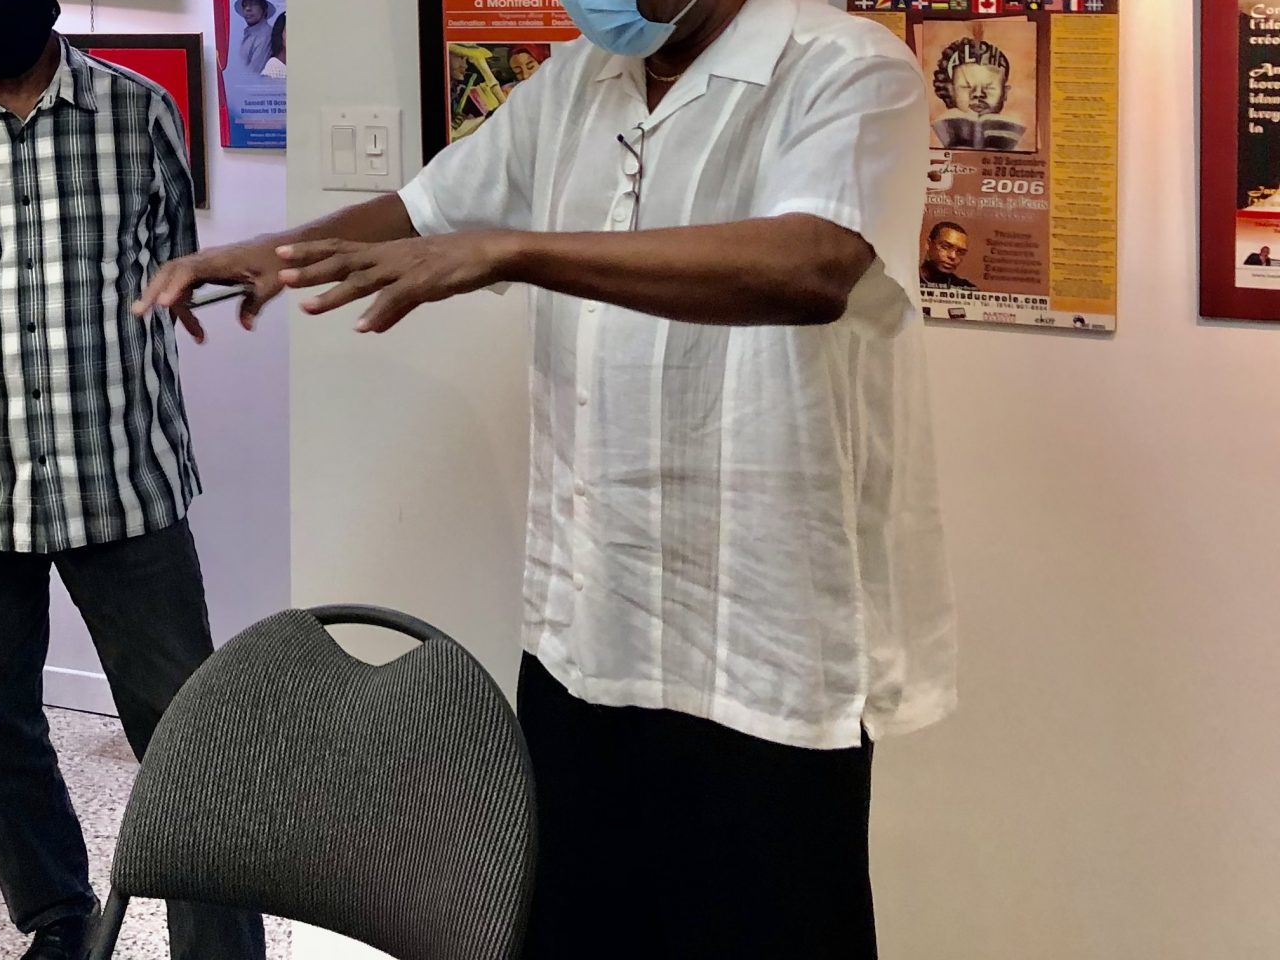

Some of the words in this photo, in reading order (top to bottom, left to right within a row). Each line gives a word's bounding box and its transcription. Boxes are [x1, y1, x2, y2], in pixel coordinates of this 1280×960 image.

[1005, 156, 1046, 167] Septembre
[982, 168, 992, 176] au
[1009, 167, 1045, 178] Octobre
[981, 178, 1044, 194] 2006
